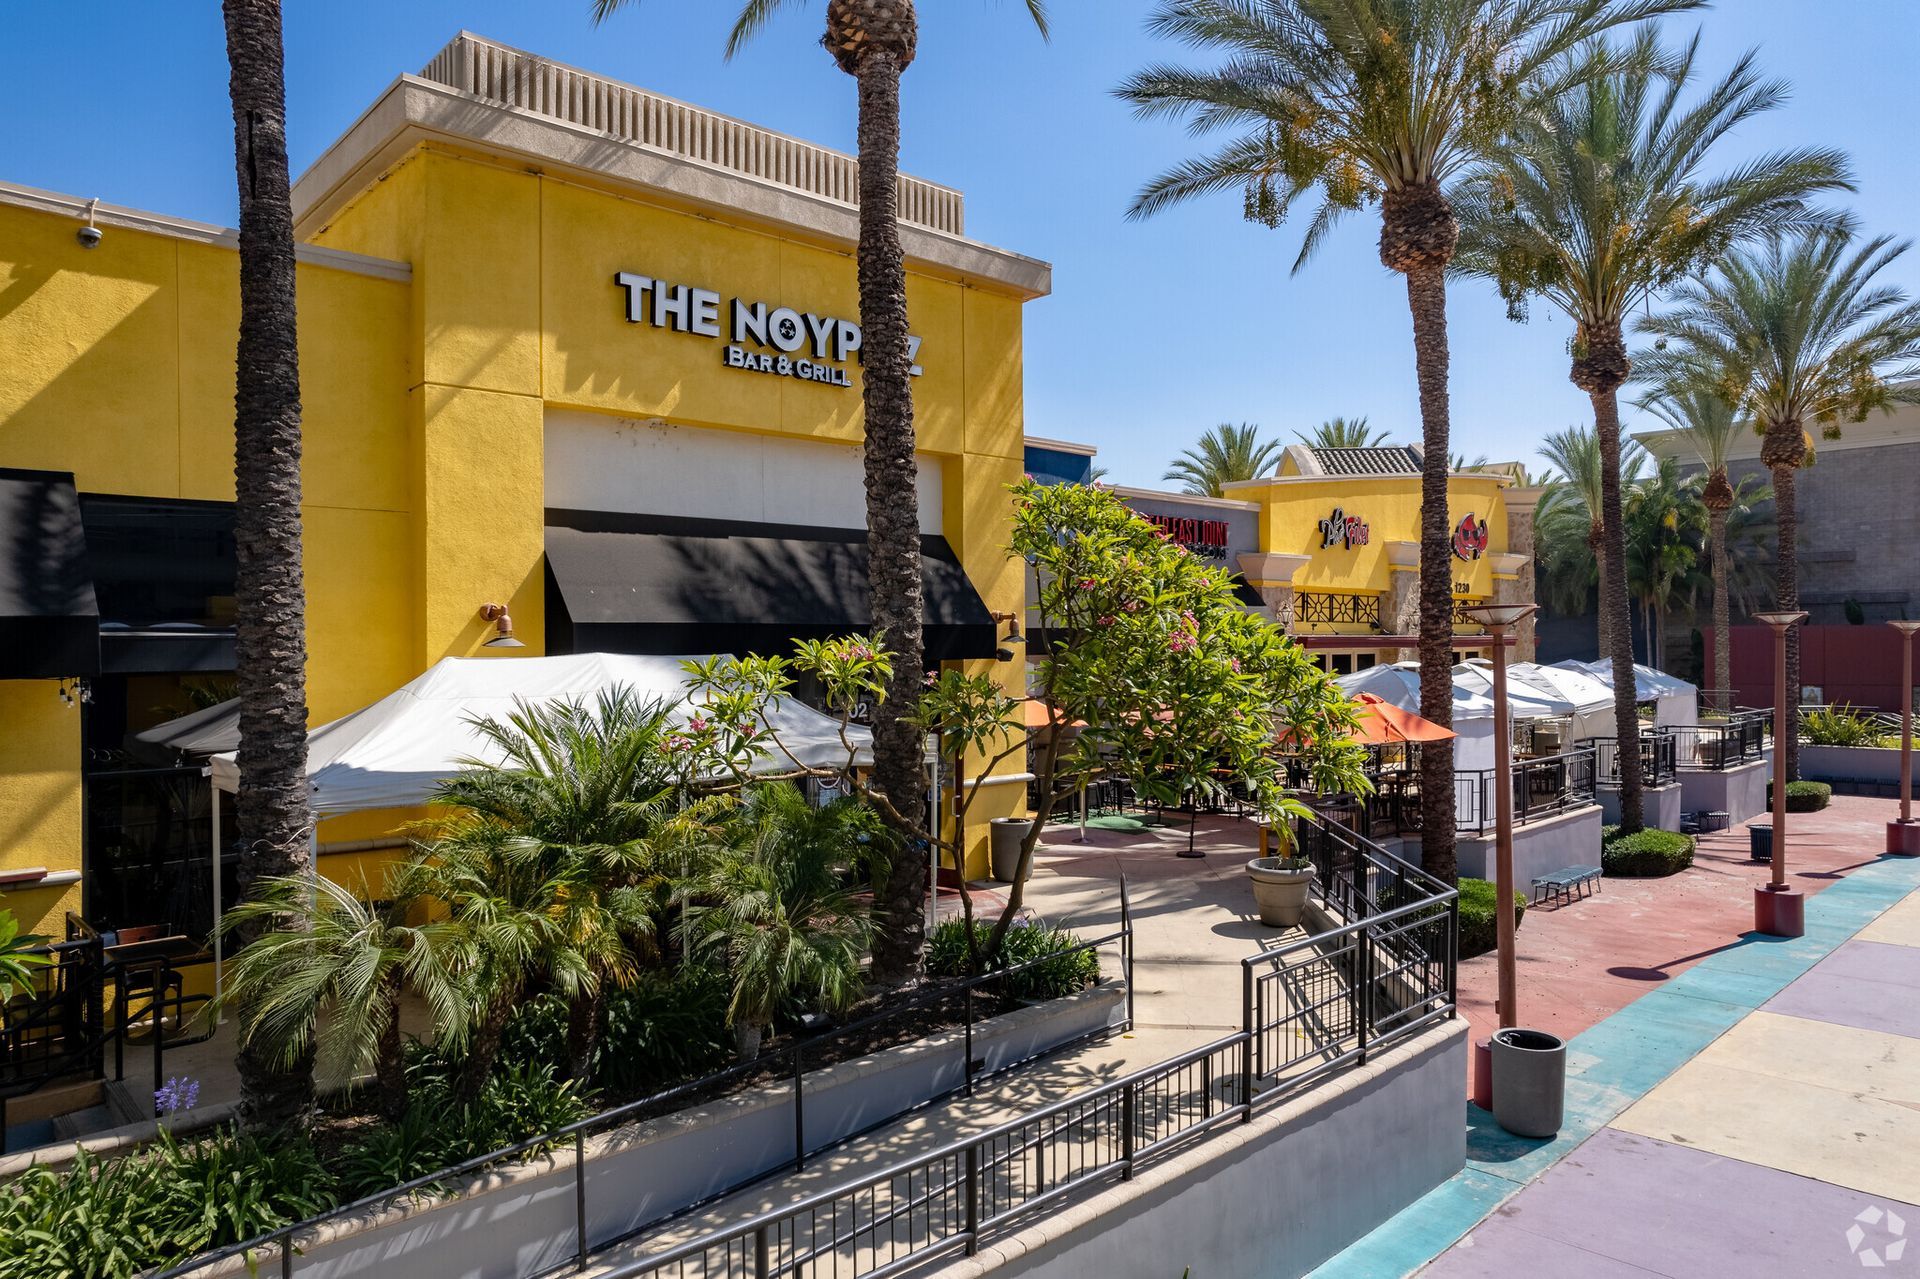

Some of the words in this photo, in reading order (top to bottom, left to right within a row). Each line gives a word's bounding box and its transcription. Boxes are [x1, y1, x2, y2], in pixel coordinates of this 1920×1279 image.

[615, 271, 720, 338] THE
[730, 296, 923, 377] NOYPZ
[724, 345, 774, 374] BAR
[775, 353, 794, 377] &
[796, 358, 852, 387] GRILL
[1172, 517, 1199, 545] EAST
[1201, 519, 1229, 547] JOINT
